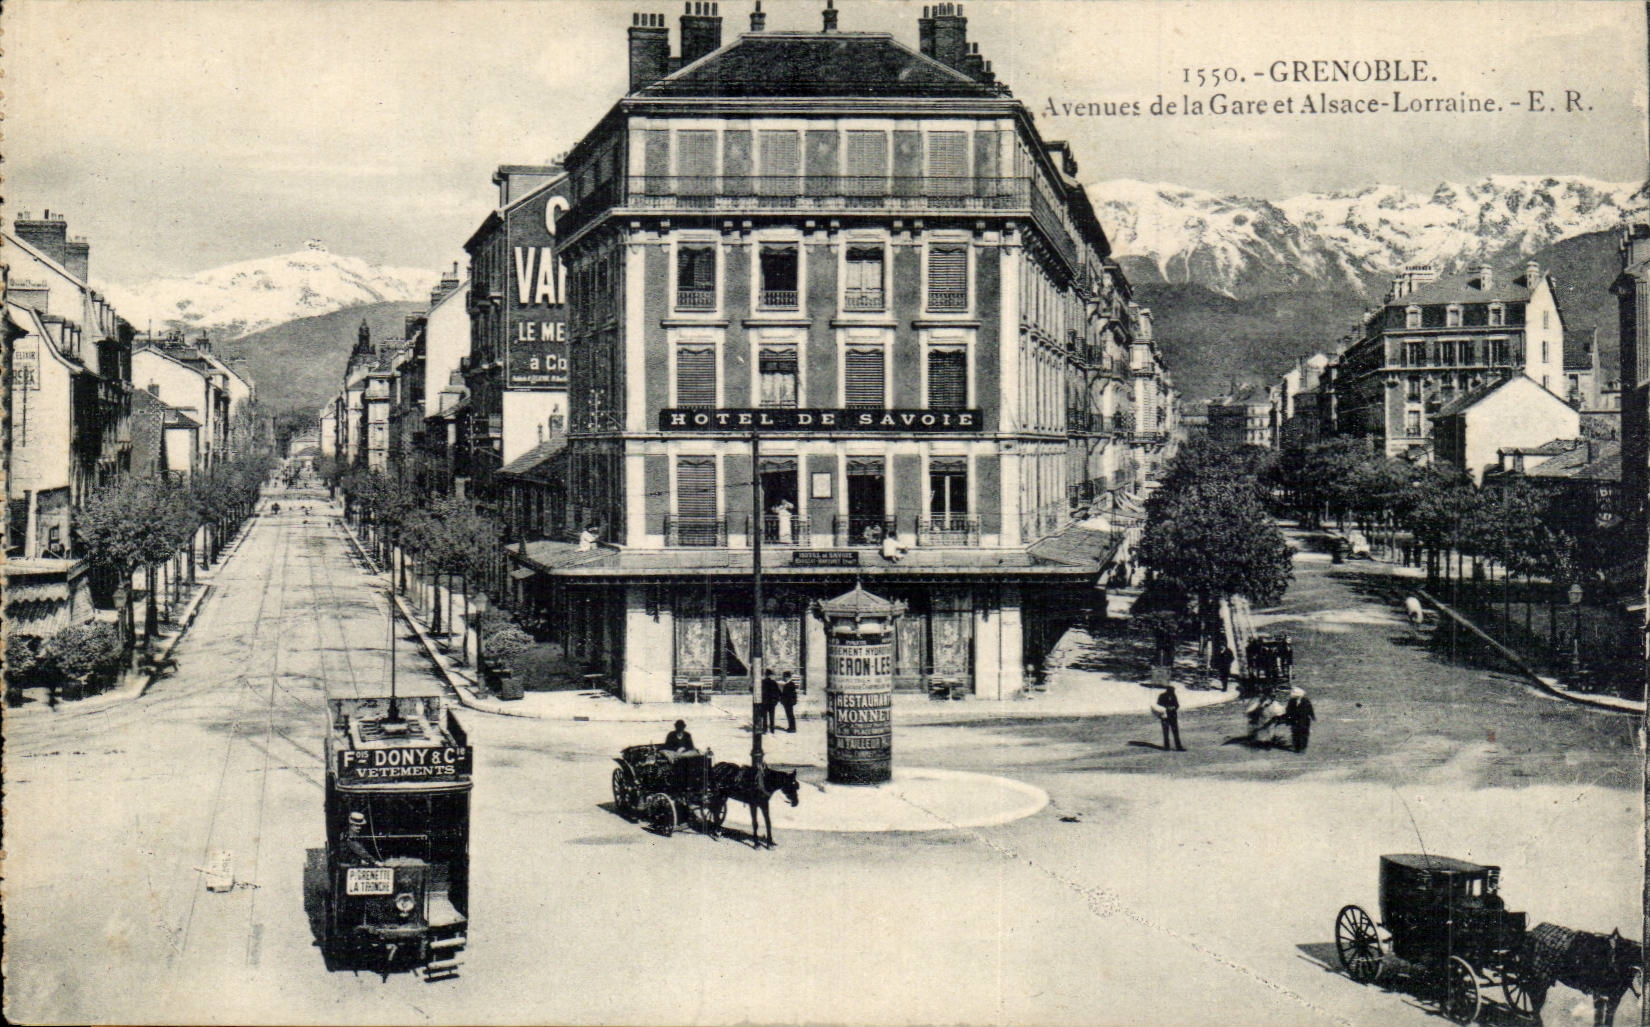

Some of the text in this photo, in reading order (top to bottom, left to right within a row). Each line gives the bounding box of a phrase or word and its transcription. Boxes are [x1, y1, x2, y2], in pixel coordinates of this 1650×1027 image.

[518, 321, 536, 342] LE
[670, 412, 973, 425] HOTEL DE SAVOIE
[375, 748, 429, 766] DONY
[431, 751, 441, 764] &
[357, 765, 455, 778] VETEMENTS
